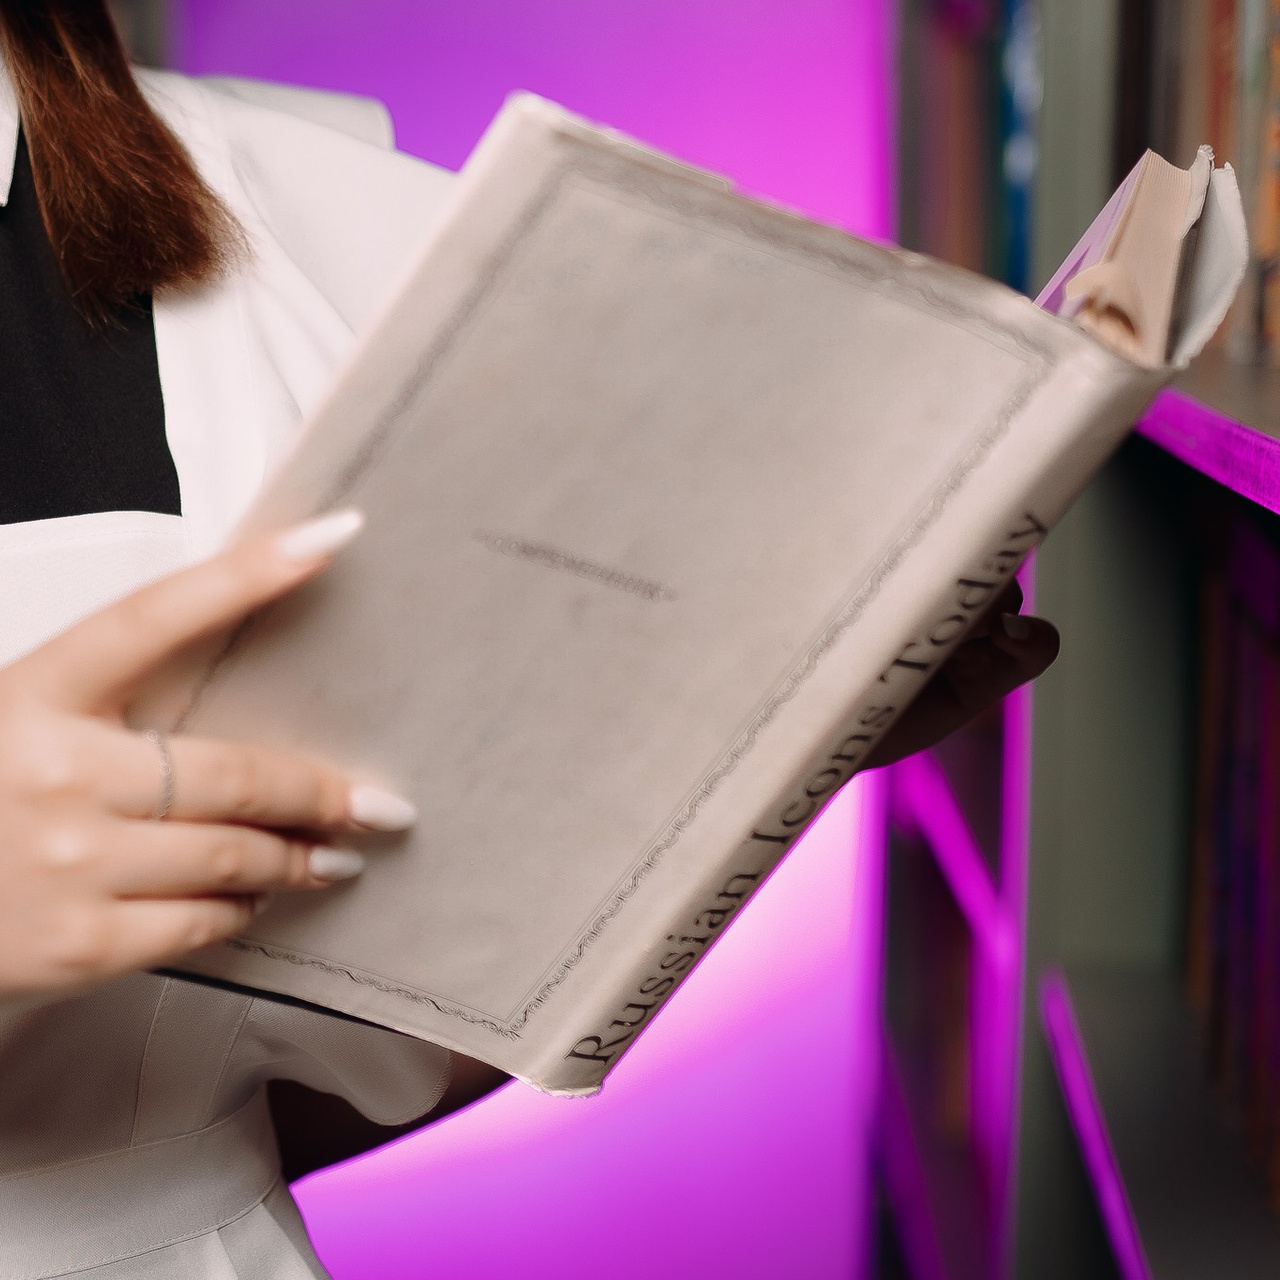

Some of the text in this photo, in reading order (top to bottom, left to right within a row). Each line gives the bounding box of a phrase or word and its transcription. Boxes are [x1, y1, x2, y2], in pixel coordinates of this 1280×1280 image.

[564, 514, 1048, 1065] Russian Icons Today
